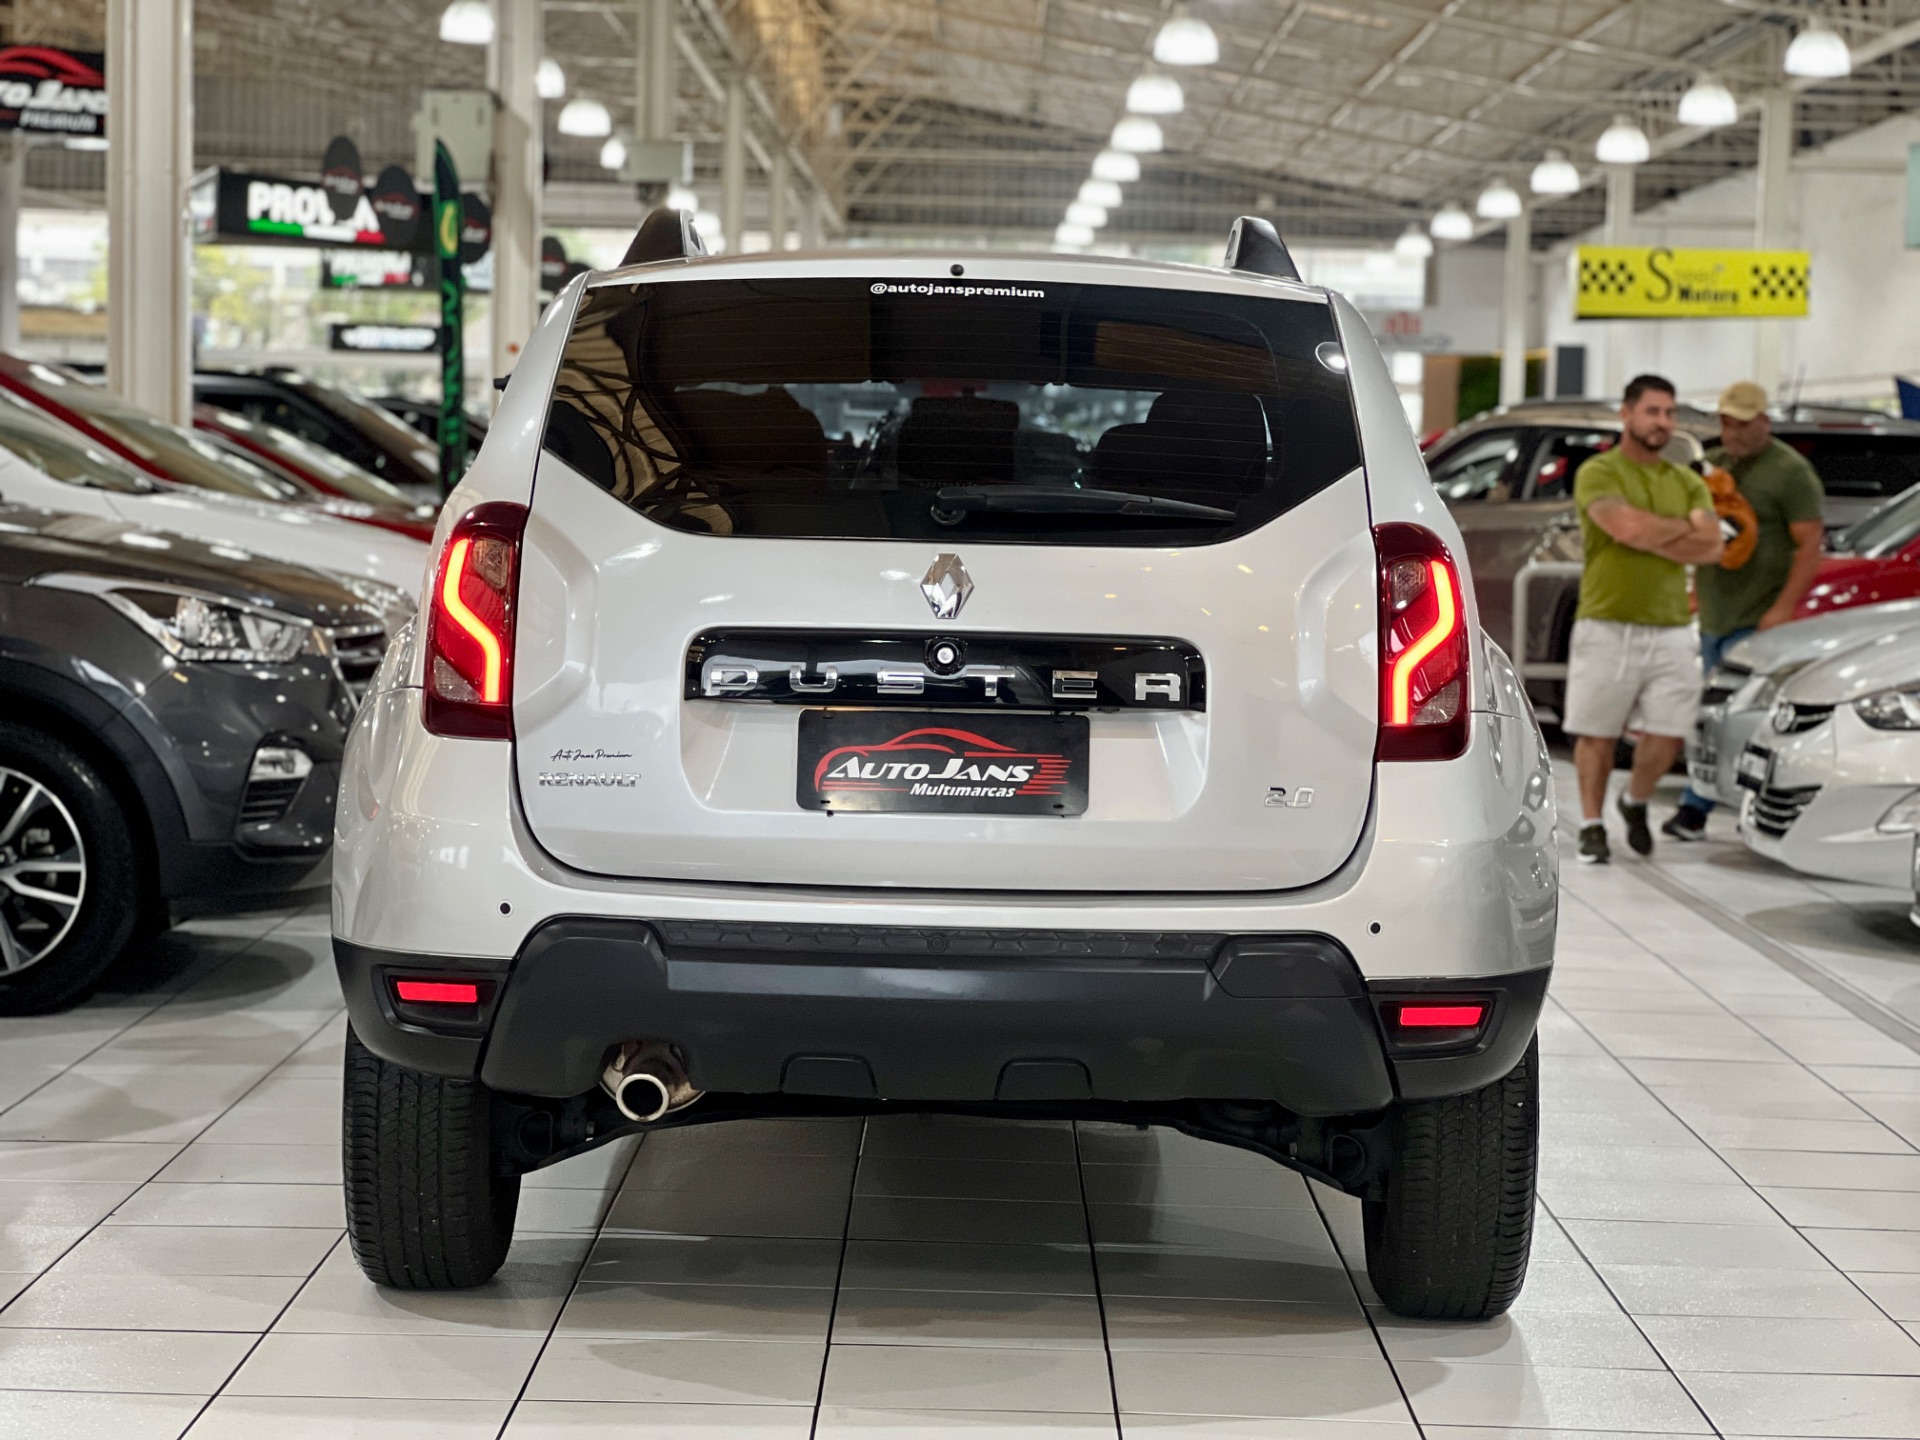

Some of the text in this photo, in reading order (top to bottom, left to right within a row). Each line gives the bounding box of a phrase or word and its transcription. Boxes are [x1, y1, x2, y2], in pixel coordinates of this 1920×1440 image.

[870, 283, 1045, 298] @autojanspremium
[710, 664, 1182, 702] DUSTER
[538, 772, 641, 788] RENAULT
[909, 783, 1017, 798] Multimarcas
[1264, 786, 1315, 809] 2.0
